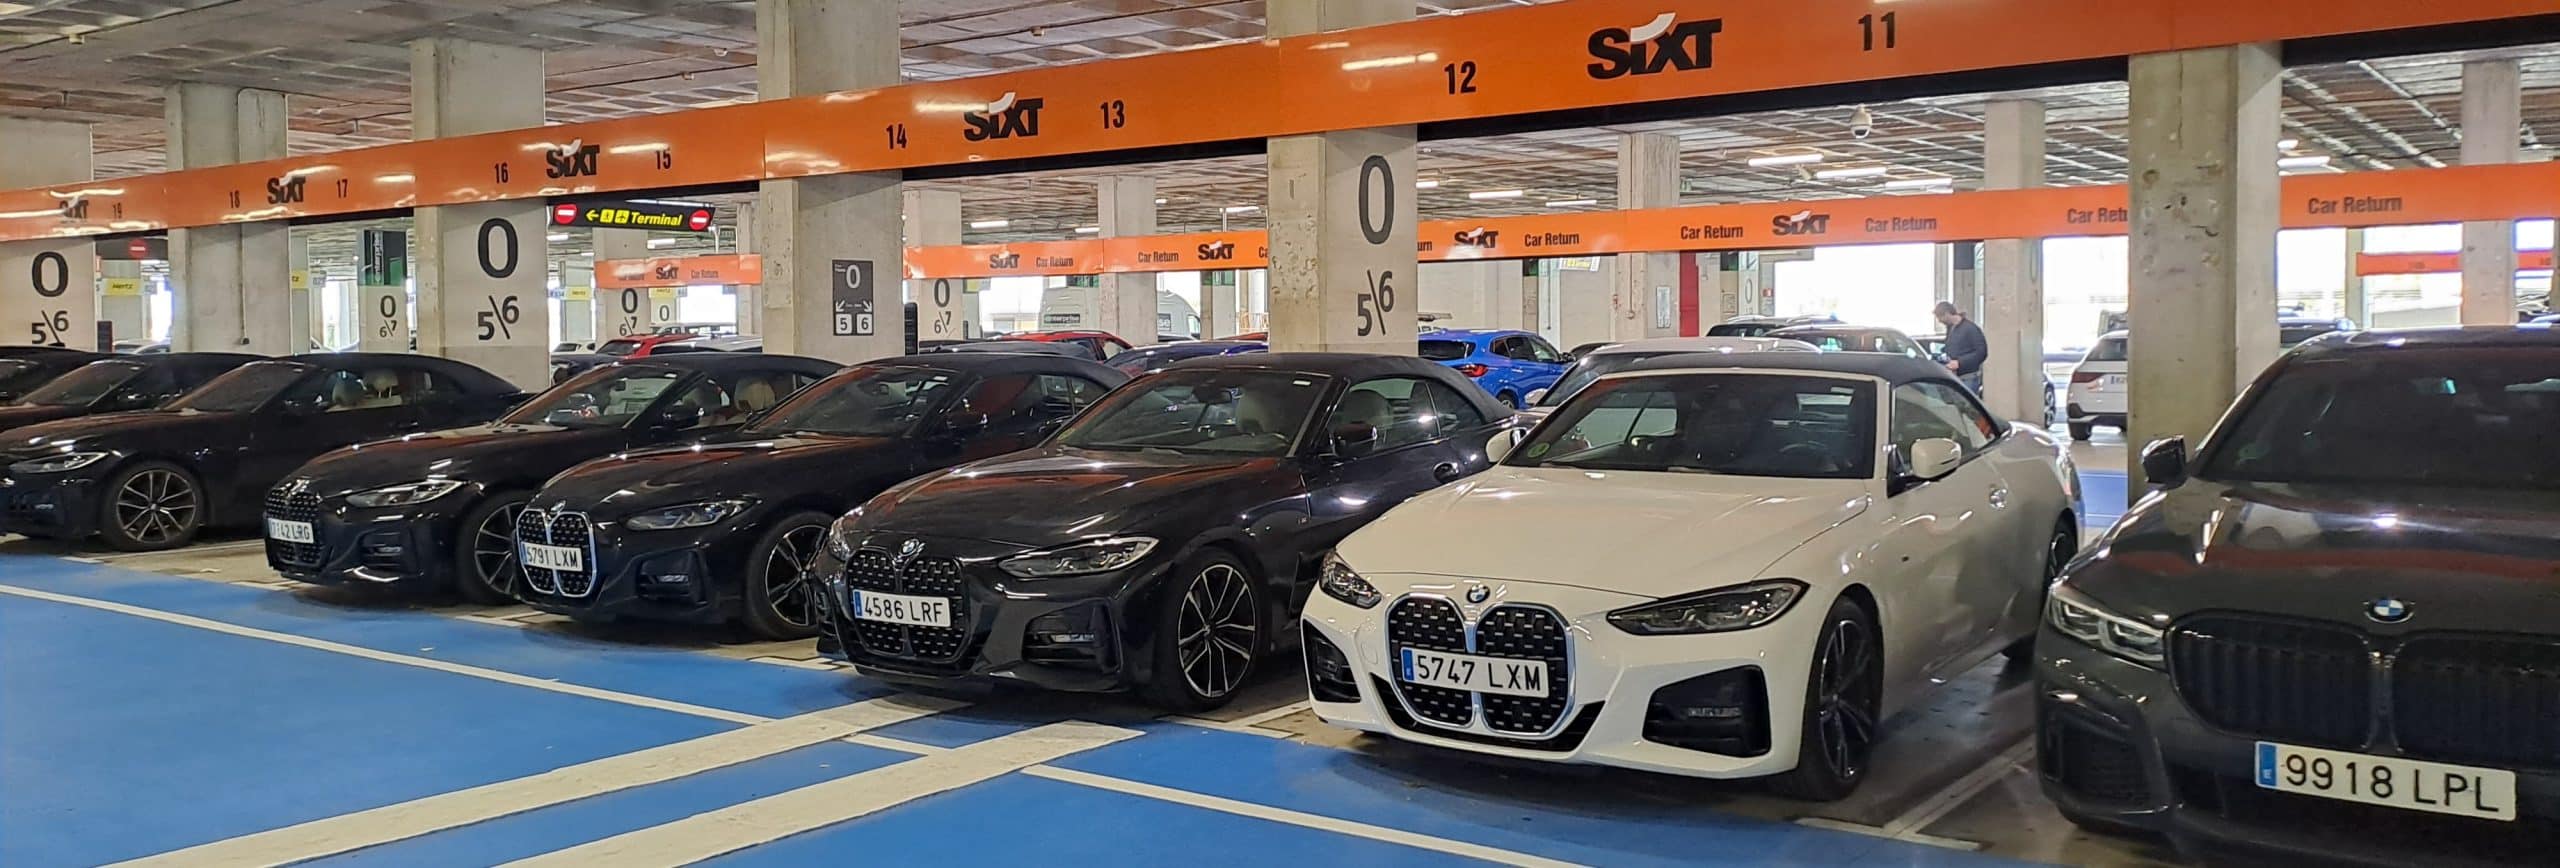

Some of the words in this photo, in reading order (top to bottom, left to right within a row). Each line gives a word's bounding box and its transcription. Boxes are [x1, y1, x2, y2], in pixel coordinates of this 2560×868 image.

[1858, 12, 1896, 52] 11
[1587, 12, 1723, 80] SIXT
[1444, 60, 1477, 96] 12
[963, 92, 1044, 142] SIXT
[1100, 100, 1126, 130] 13
[886, 123, 908, 150] 14
[546, 138, 601, 179] SIXT
[655, 149, 672, 171] 15
[494, 162, 509, 185] 16
[267, 171, 306, 204] SIXT
[337, 178, 348, 200] 17
[229, 190, 240, 209] 18
[1358, 154, 1395, 245] 0
[2308, 198, 2337, 214] Car
[2343, 196, 2403, 212] Return
[631, 211, 683, 226] Terminal
[1772, 210, 1830, 236] SIXT
[1865, 217, 1888, 233] Car
[1892, 216, 1938, 231] Return
[2067, 207, 2094, 223] Car
[2098, 206, 2129, 222] Retu
[1454, 226, 1499, 248] SIXT
[1524, 233, 1542, 247] Car
[1545, 232, 1580, 246] Return
[1680, 225, 1700, 240] Car
[1704, 225, 1744, 239] Return
[477, 217, 519, 279] 0
[1138, 251, 1152, 263] Car
[1153, 251, 1179, 262] Return
[1198, 240, 1235, 260] SIXT
[990, 250, 1020, 269] SIXT
[31, 251, 69, 298] 0
[839, 317, 848, 331] 5
[861, 317, 869, 331] 6
[527, 546, 550, 566] 5791
[553, 549, 578, 568] LXM
[864, 596, 904, 620] 4586
[910, 599, 942, 623] LRF
[1416, 655, 1475, 685] 5747
[1488, 662, 1541, 692] LXM
[2285, 754, 2394, 799] 9918
[2414, 768, 2499, 813] LPL
